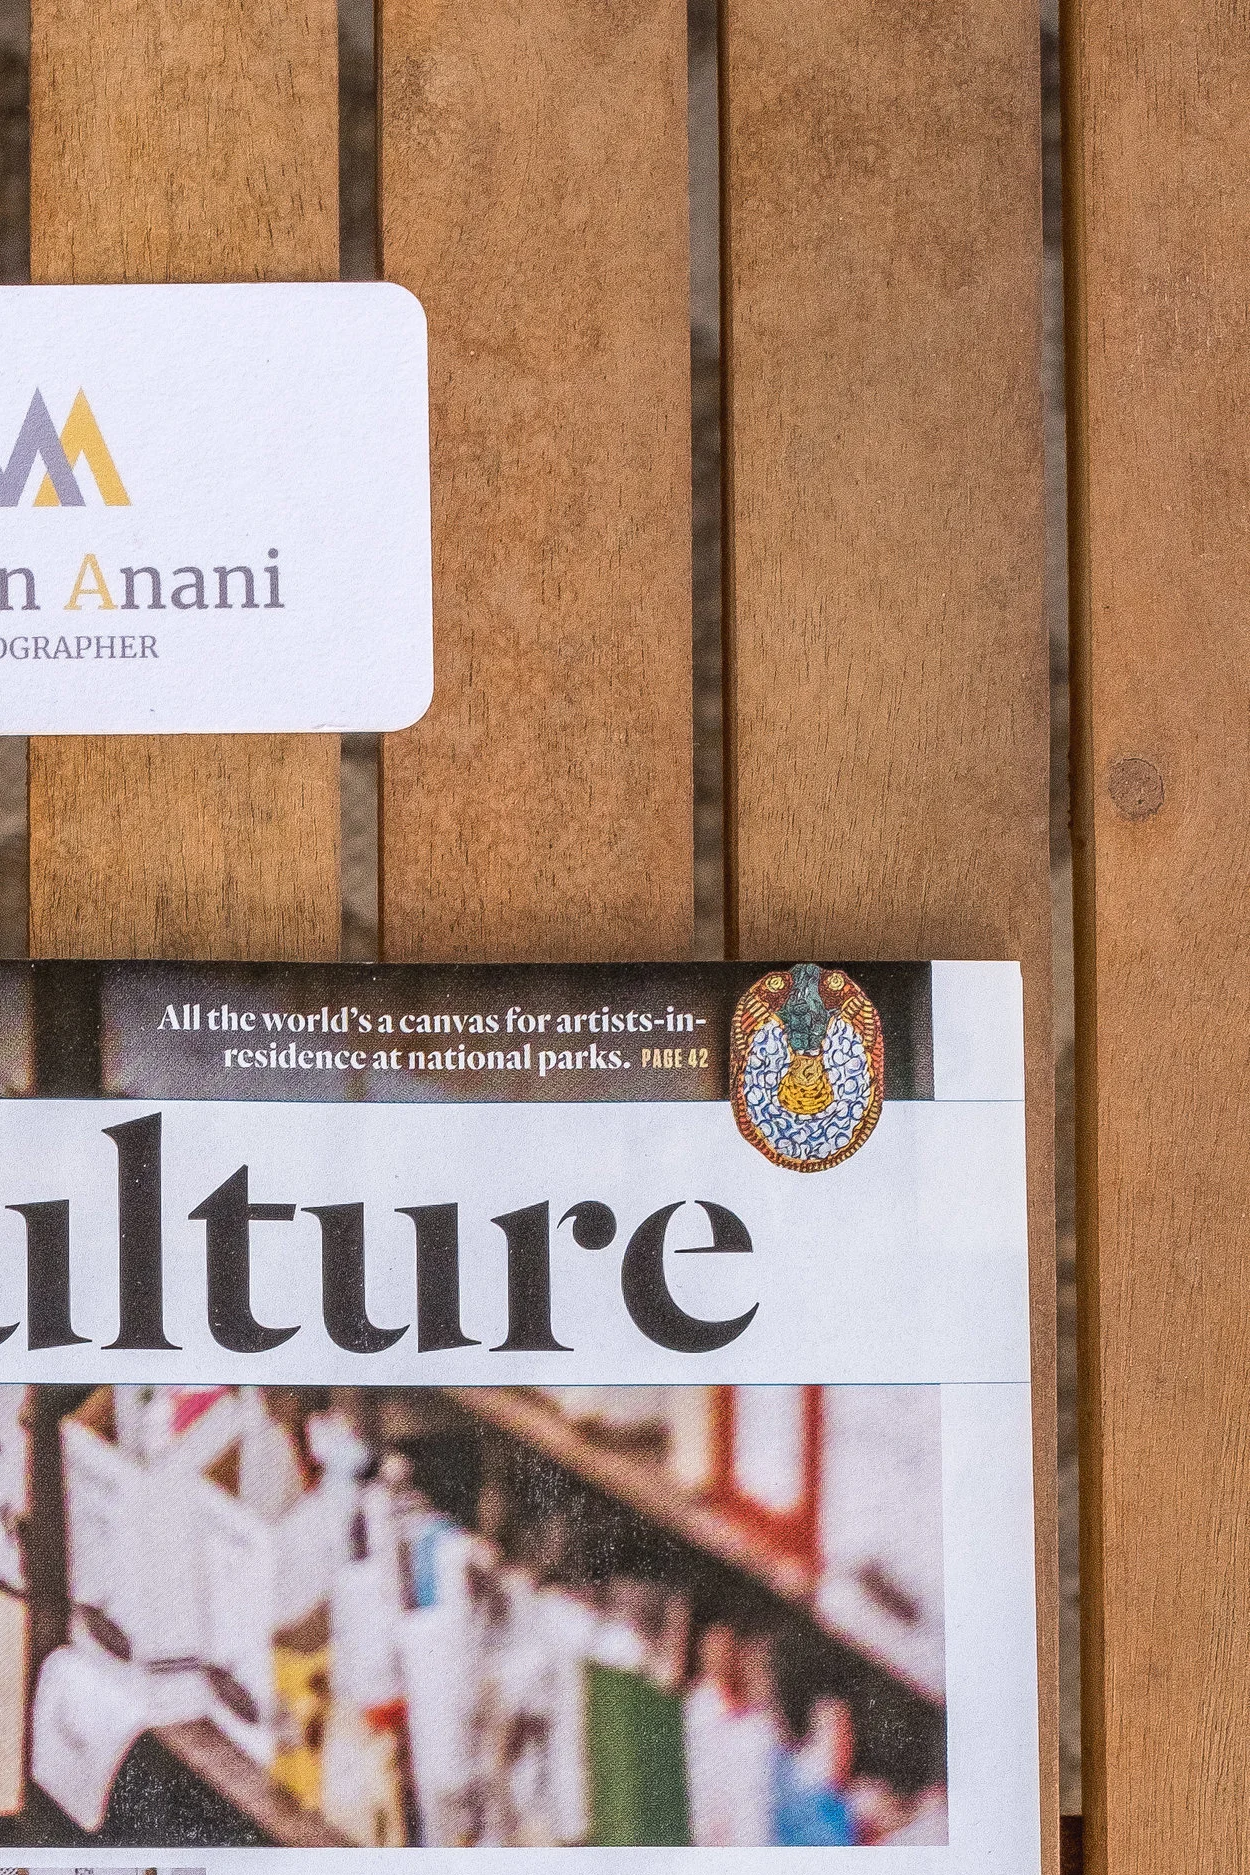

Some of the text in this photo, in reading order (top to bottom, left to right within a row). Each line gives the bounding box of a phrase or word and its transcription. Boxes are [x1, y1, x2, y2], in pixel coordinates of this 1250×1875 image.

[63, 547, 286, 612] Anani
[156, 1003, 707, 1034] All the world’s a canvas for artists-in-
[223, 1042, 711, 1077] residence at national parks. PAGE 42
